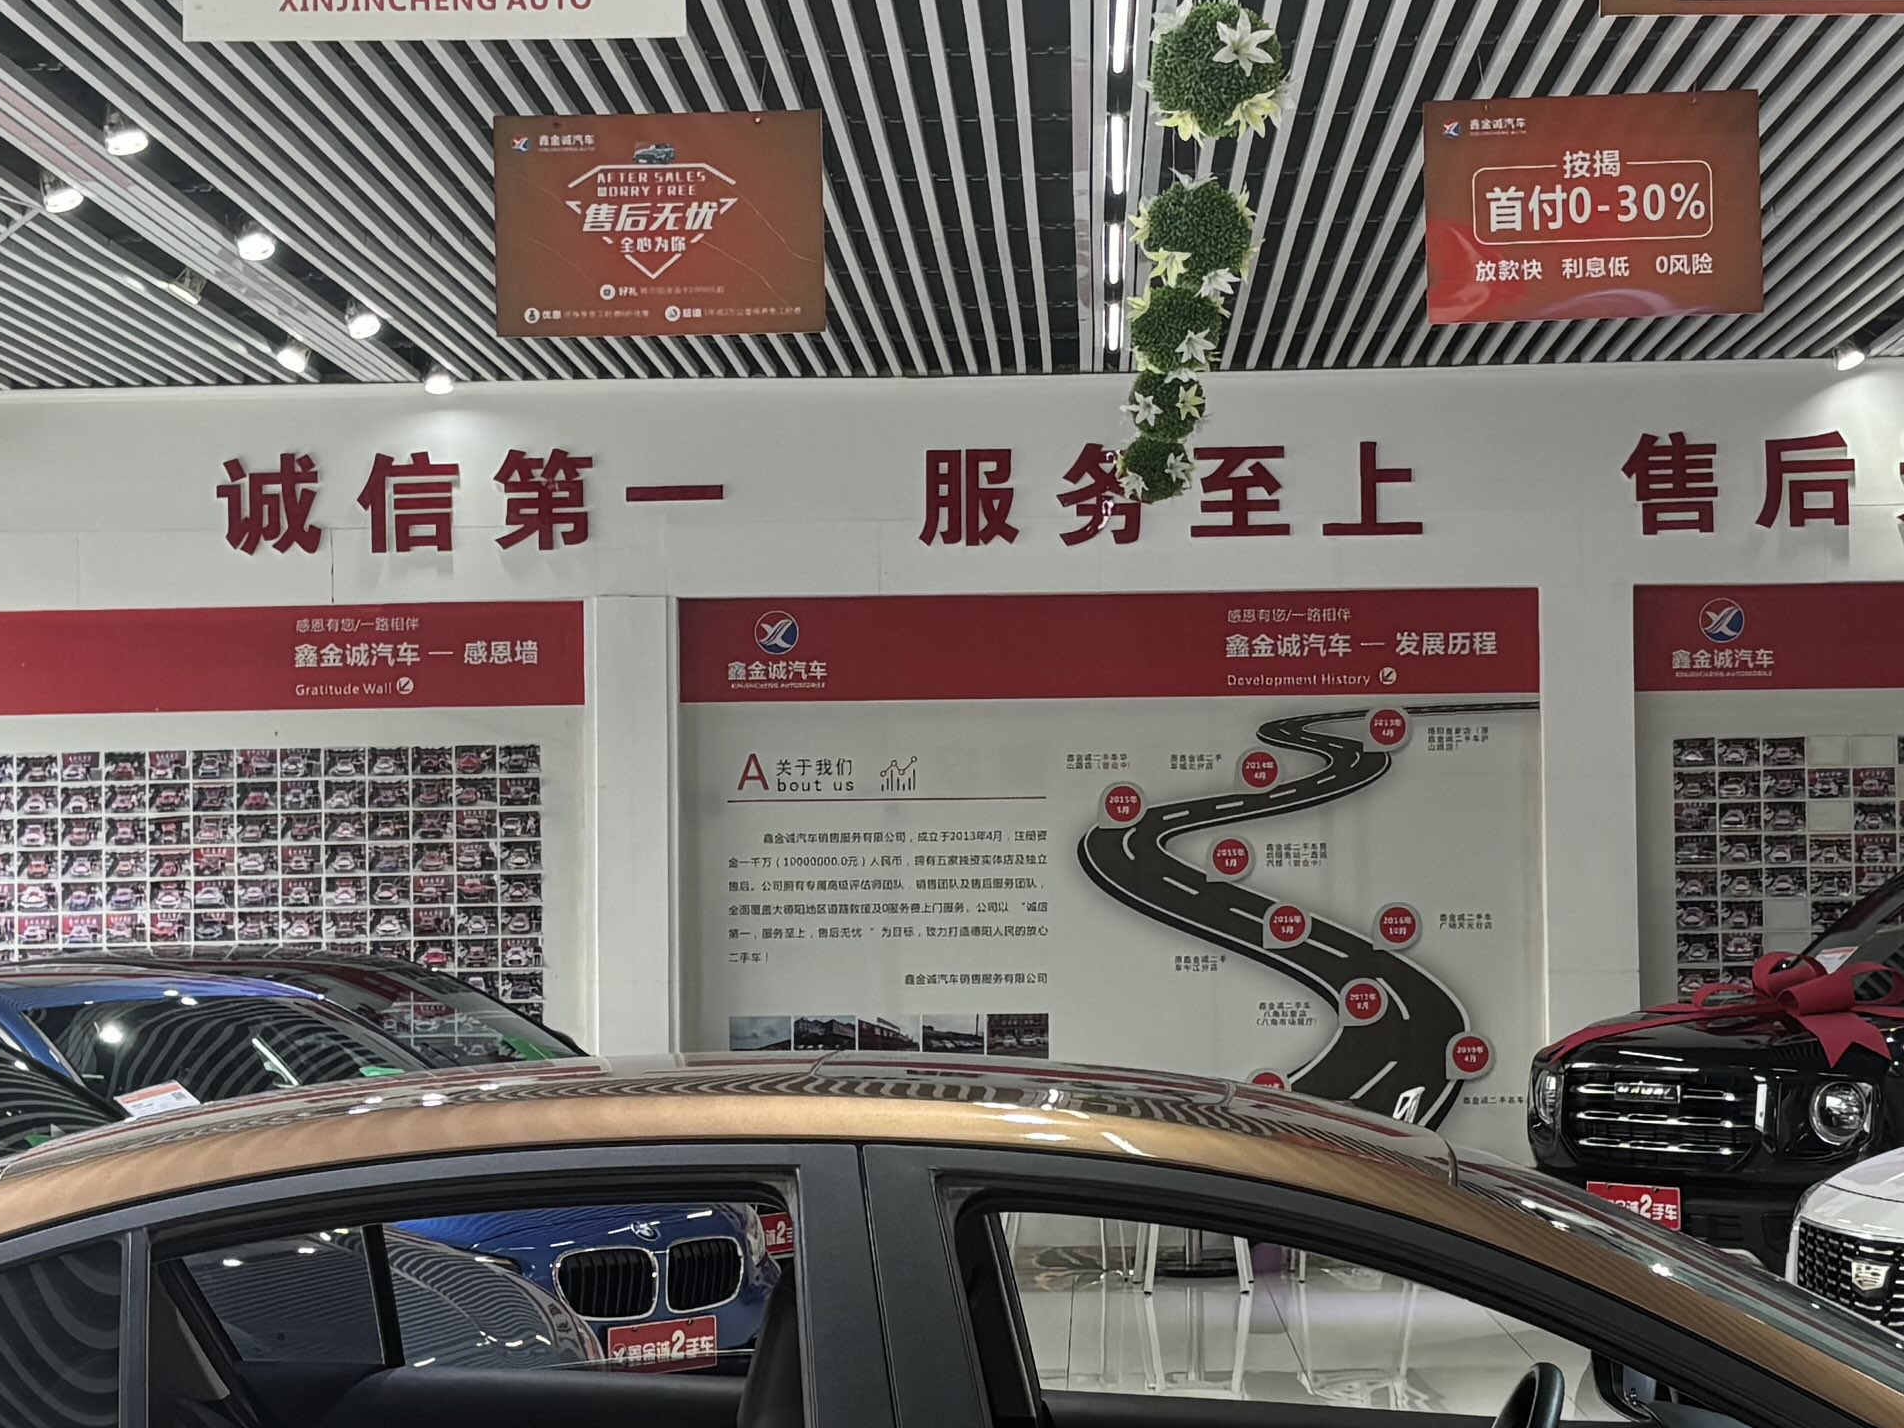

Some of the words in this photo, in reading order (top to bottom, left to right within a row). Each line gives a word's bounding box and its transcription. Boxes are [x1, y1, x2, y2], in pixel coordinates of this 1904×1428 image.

[539, 134, 595, 147] 鑫金诚汽车
[1563, 150, 1621, 179] 按揭
[597, 172, 648, 184] AFTER
[655, 171, 706, 183] SALES
[597, 186, 649, 197] WORRY
[657, 185, 697, 196] FREE
[582, 202, 719, 232] 售后无忧
[1485, 182, 1706, 233] 首付0-30%
[620, 236, 687, 254] 全心为你
[1475, 259, 1543, 282] 放款快
[1562, 256, 1630, 279] 利息低
[1656, 253, 1714, 277] 0风险
[216, 448, 725, 555] 诚信第一
[919, 440, 1424, 548] 服务至上
[294, 643, 421, 667] 鑫金诚汽车
[463, 641, 538, 665] 感恩墙
[1226, 633, 1352, 658] 鑫金诚汽车
[1395, 632, 1498, 656] 发展历程
[1672, 649, 1774, 669] 鑫金诚汽车
[727, 660, 827, 681] 鑫金诚汽车
[295, 683, 360, 696] Gratitude
[363, 682, 392, 695] Wall
[1227, 673, 1318, 689] Development
[1321, 673, 1371, 688] History
[776, 758, 853, 777] 关于我们
[833, 780, 855, 792] us
